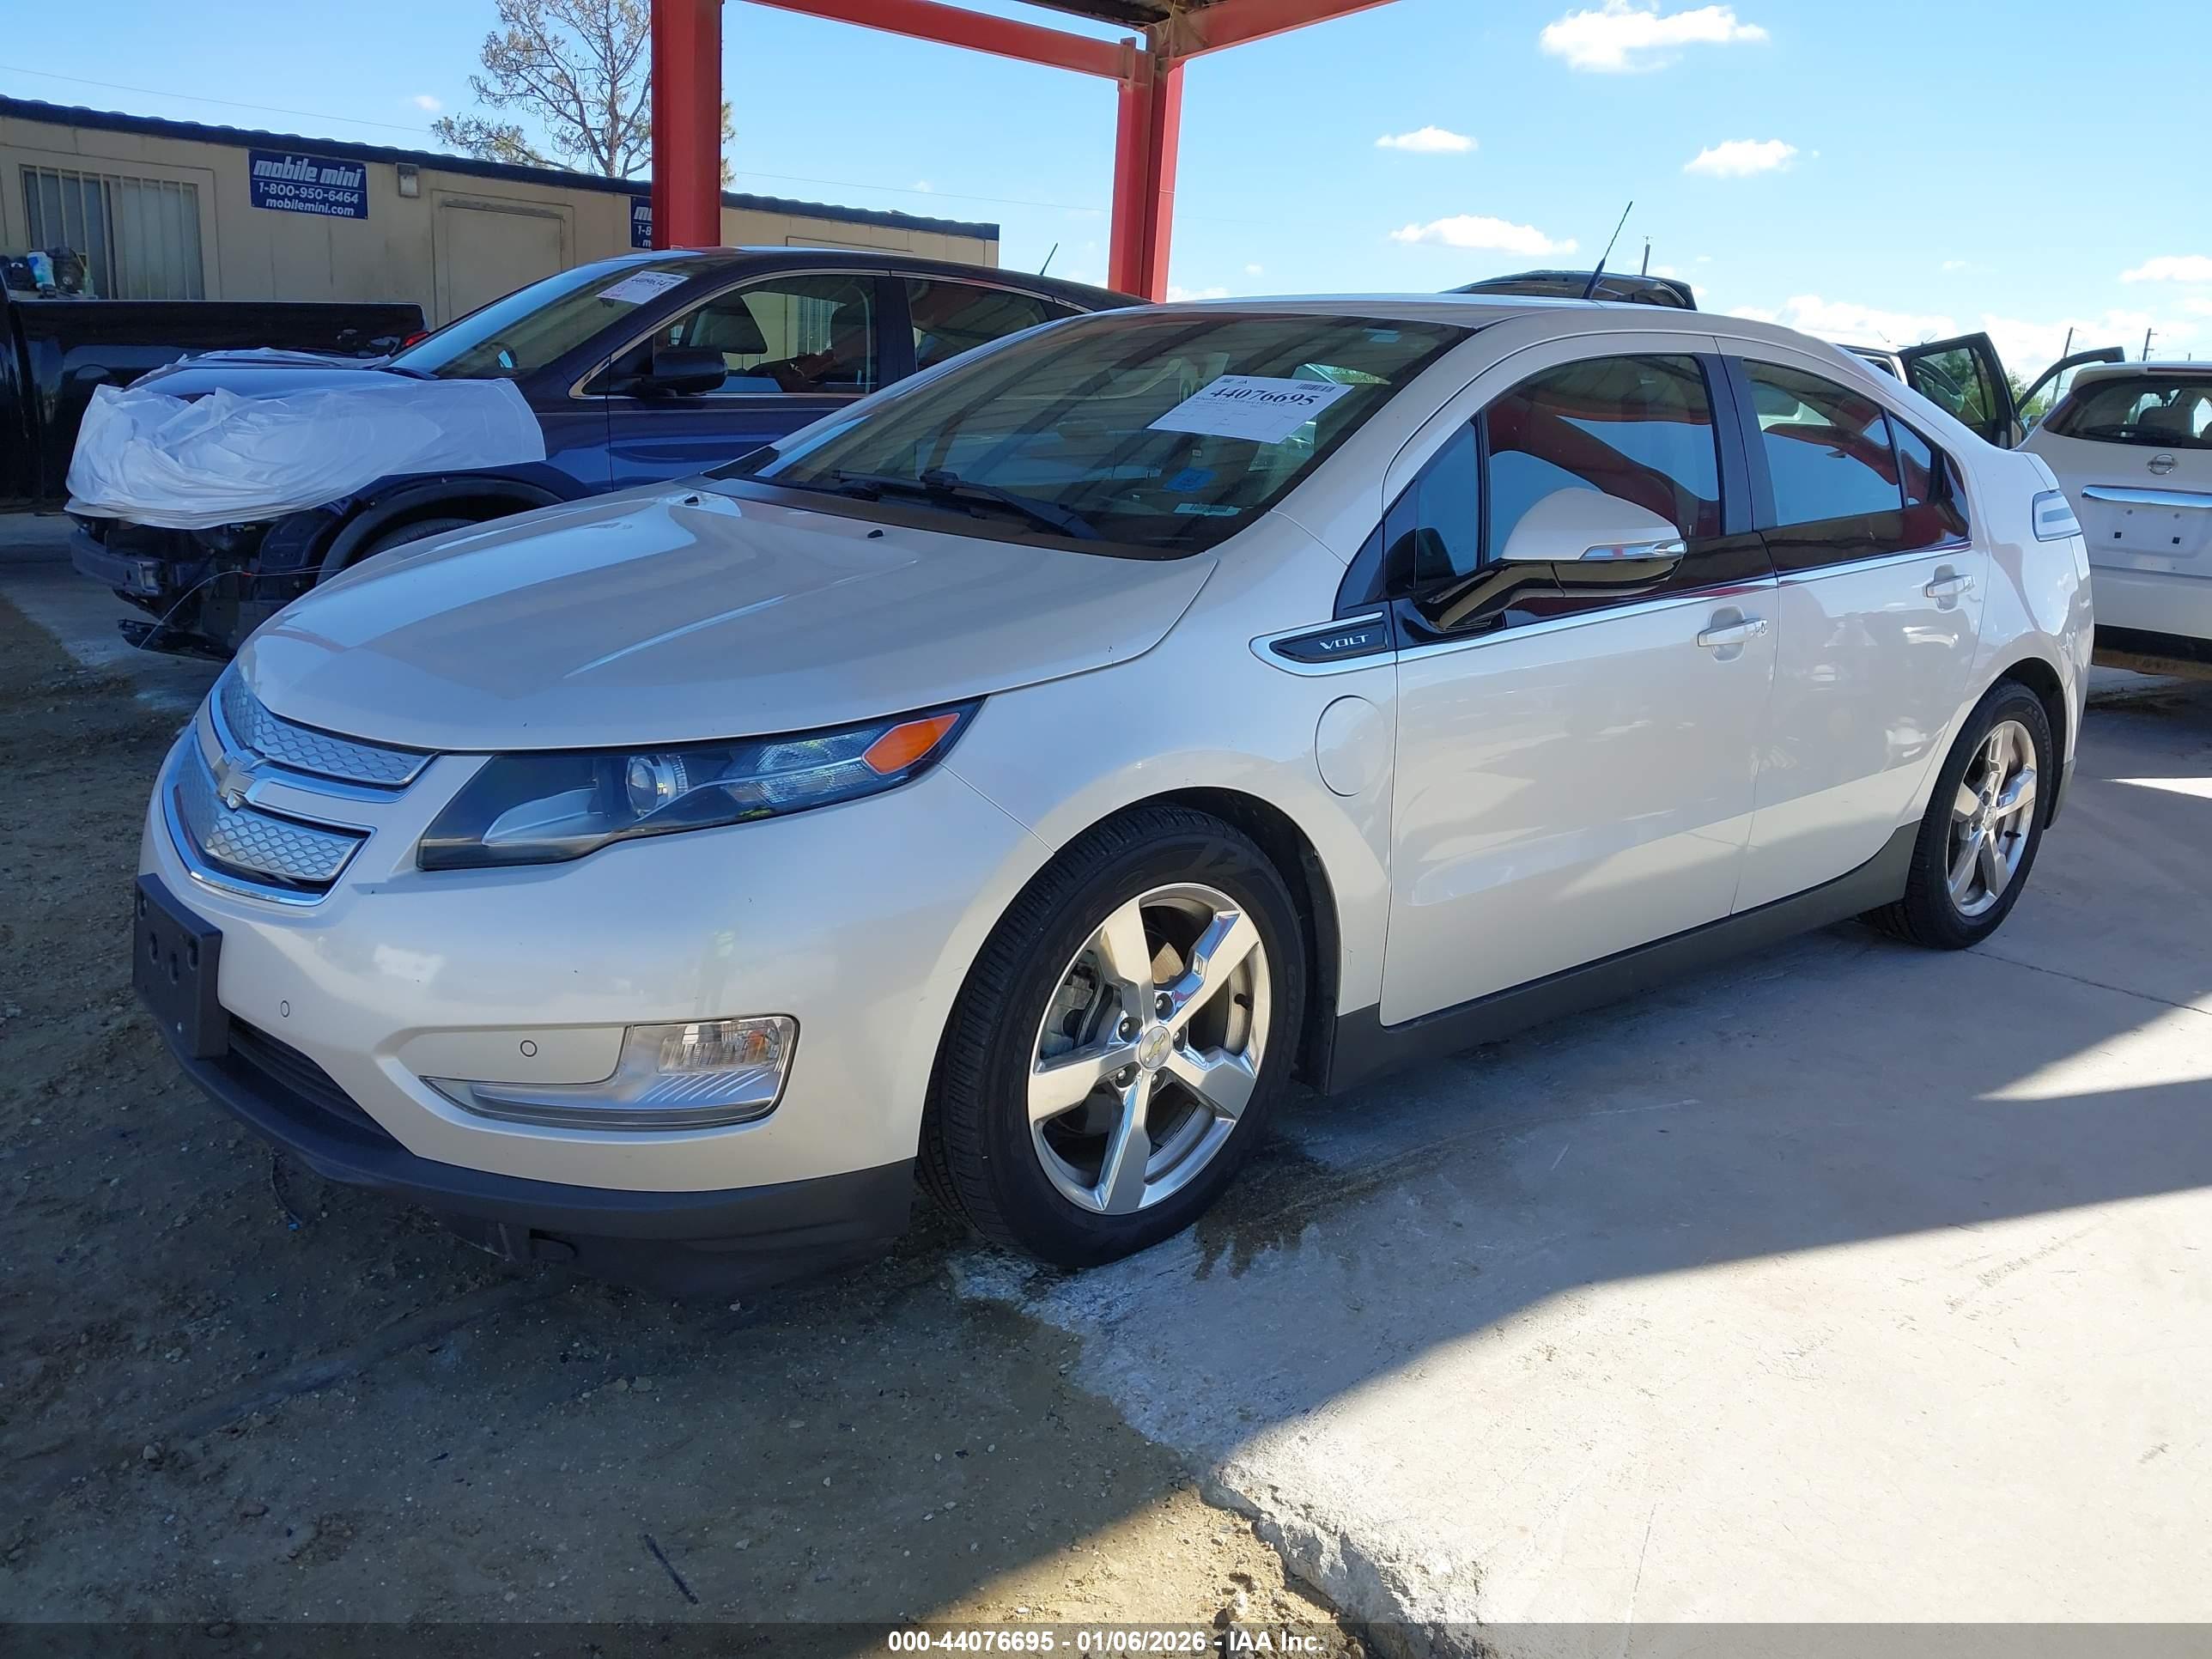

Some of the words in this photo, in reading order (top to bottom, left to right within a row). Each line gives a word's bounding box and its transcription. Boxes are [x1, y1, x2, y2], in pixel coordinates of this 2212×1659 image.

[253, 156, 318, 182] mobile
[319, 166, 364, 187] mini
[258, 182, 359, 204] 1-800-950-6464
[265, 198, 355, 216] mobilemini.com
[1210, 386, 1321, 406] 44076695
[1319, 634, 1369, 650] VOLT
